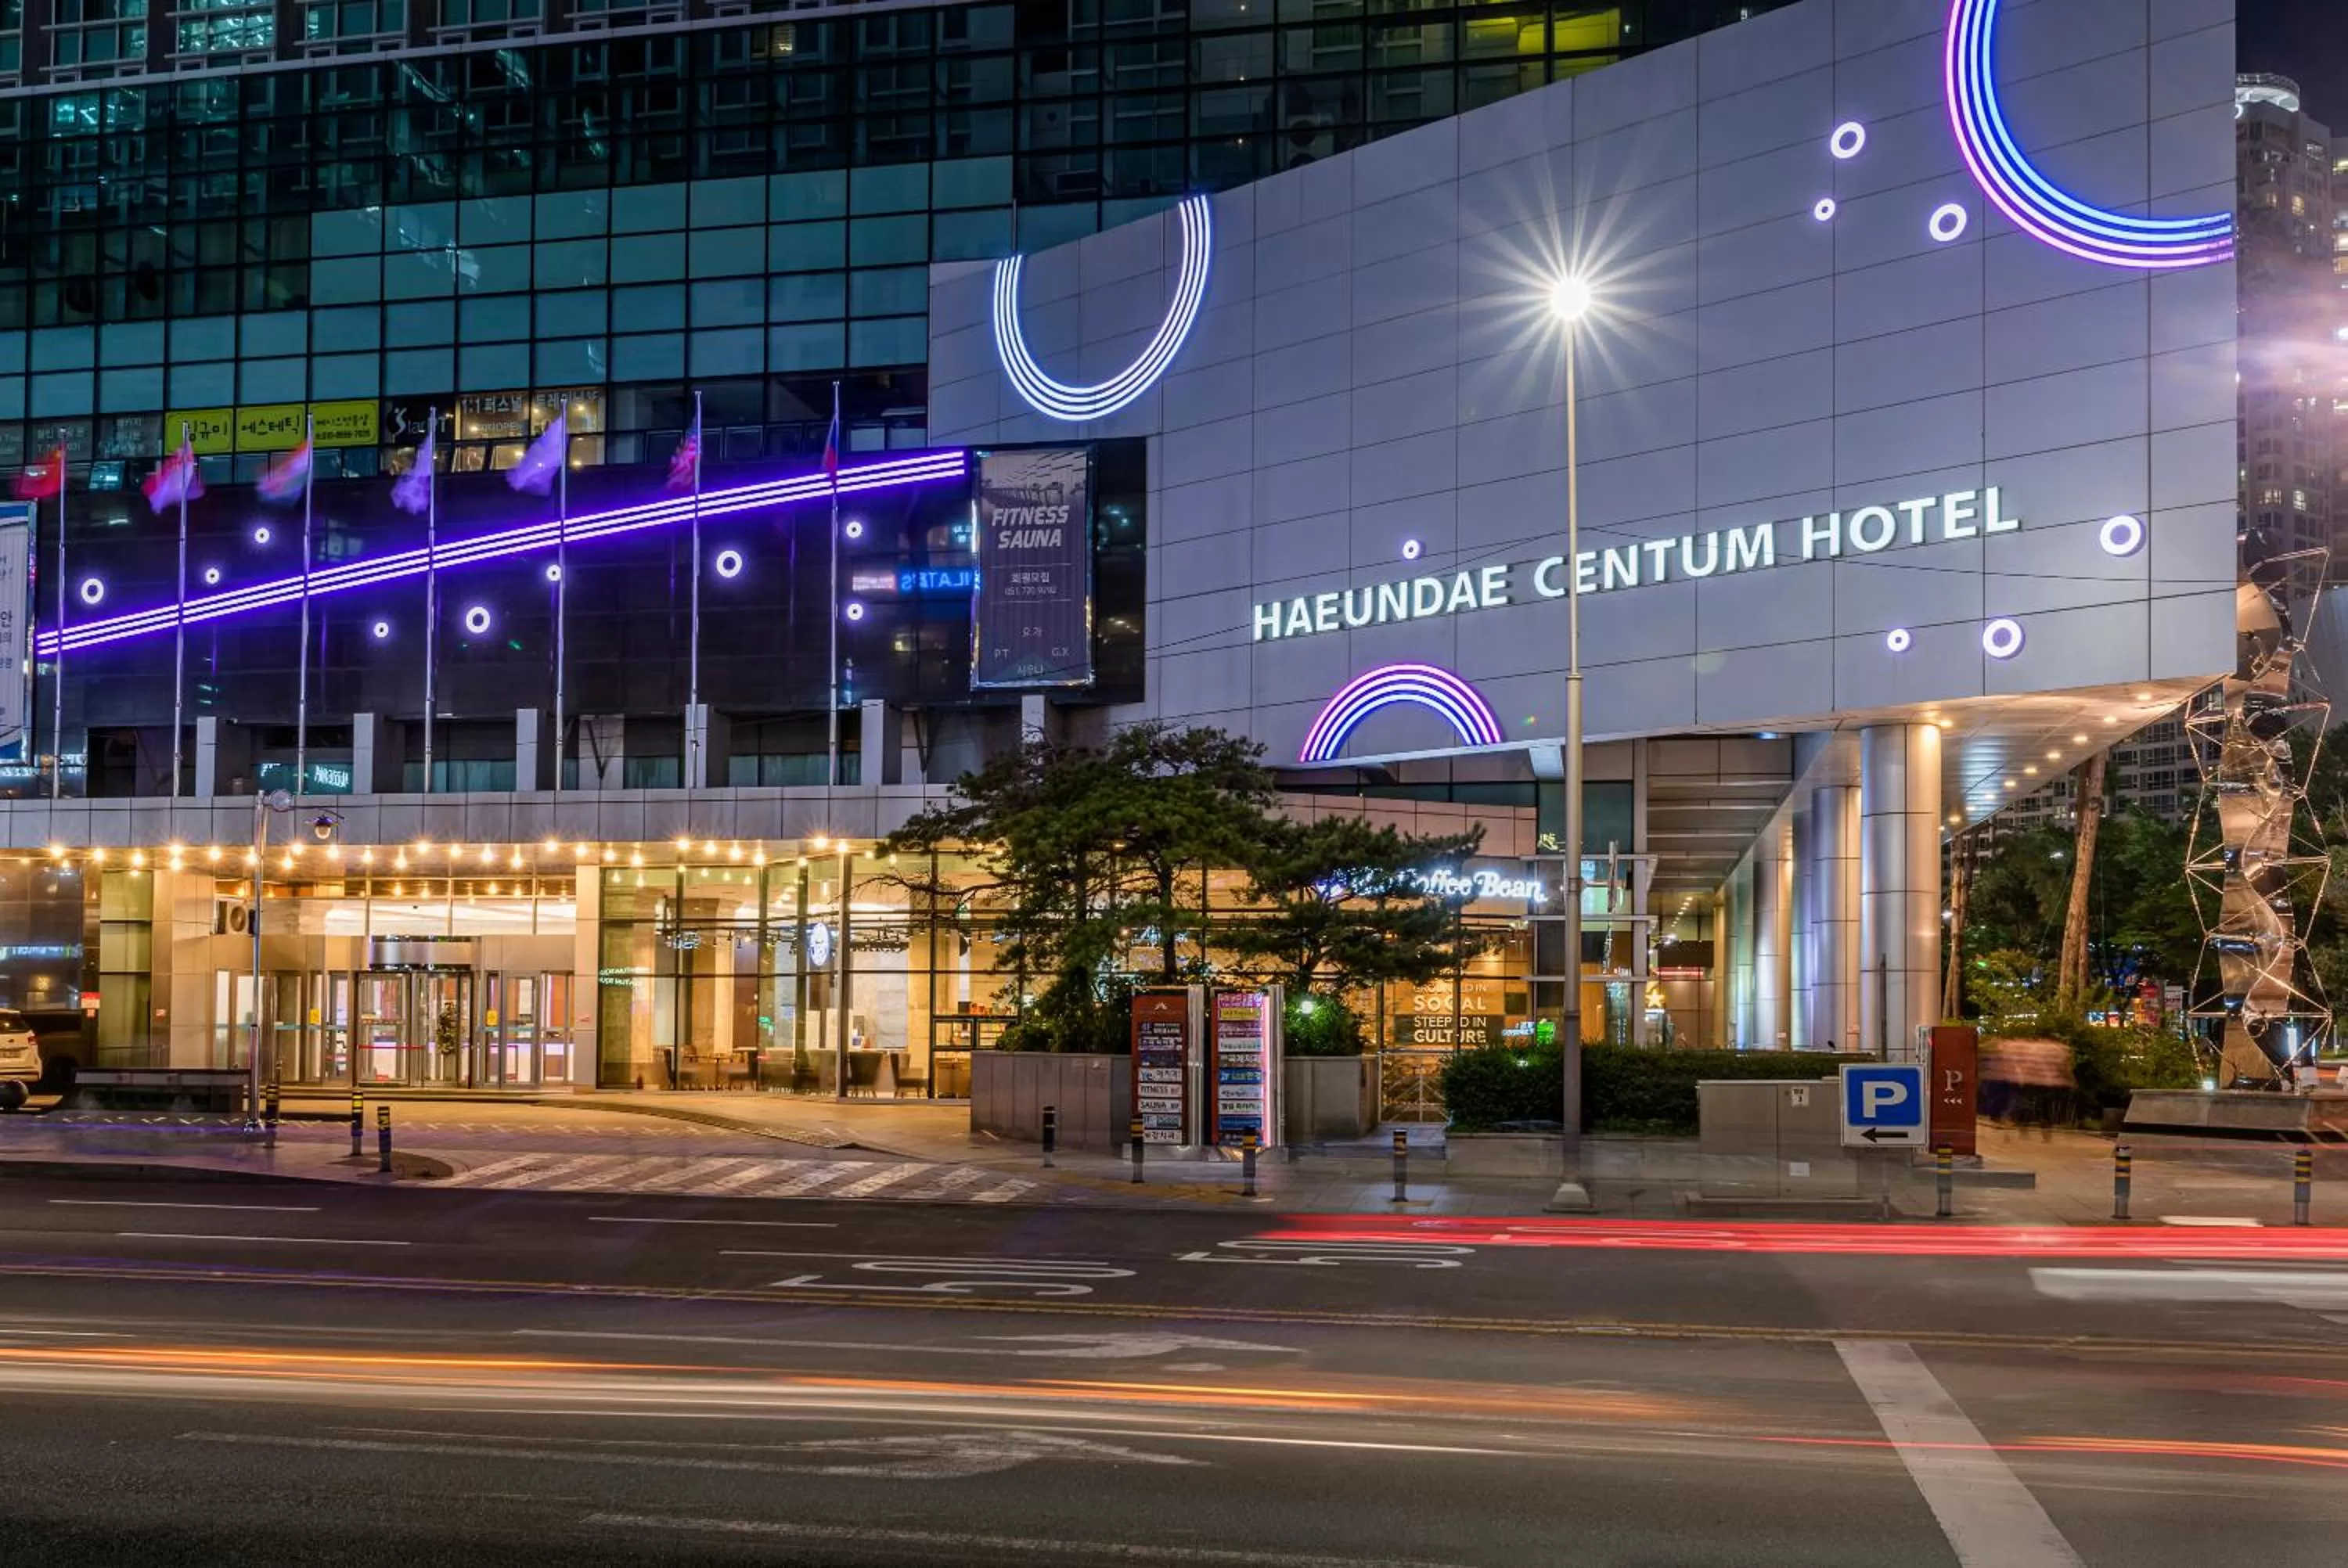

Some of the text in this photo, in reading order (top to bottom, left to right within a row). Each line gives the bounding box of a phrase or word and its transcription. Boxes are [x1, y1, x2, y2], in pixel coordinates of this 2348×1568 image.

[992, 505, 1070, 527] FITNESS
[998, 528, 1063, 548] SAUNA
[1252, 486, 2019, 639] HAEUNDAE CENTUM HOTEL
[1474, 871, 1547, 901] Bean
[1414, 994, 1486, 1012] SOCAL
[1414, 1016, 1469, 1027] STEEPD
[1944, 1070, 1963, 1091] P
[1862, 1081, 1908, 1118] P
